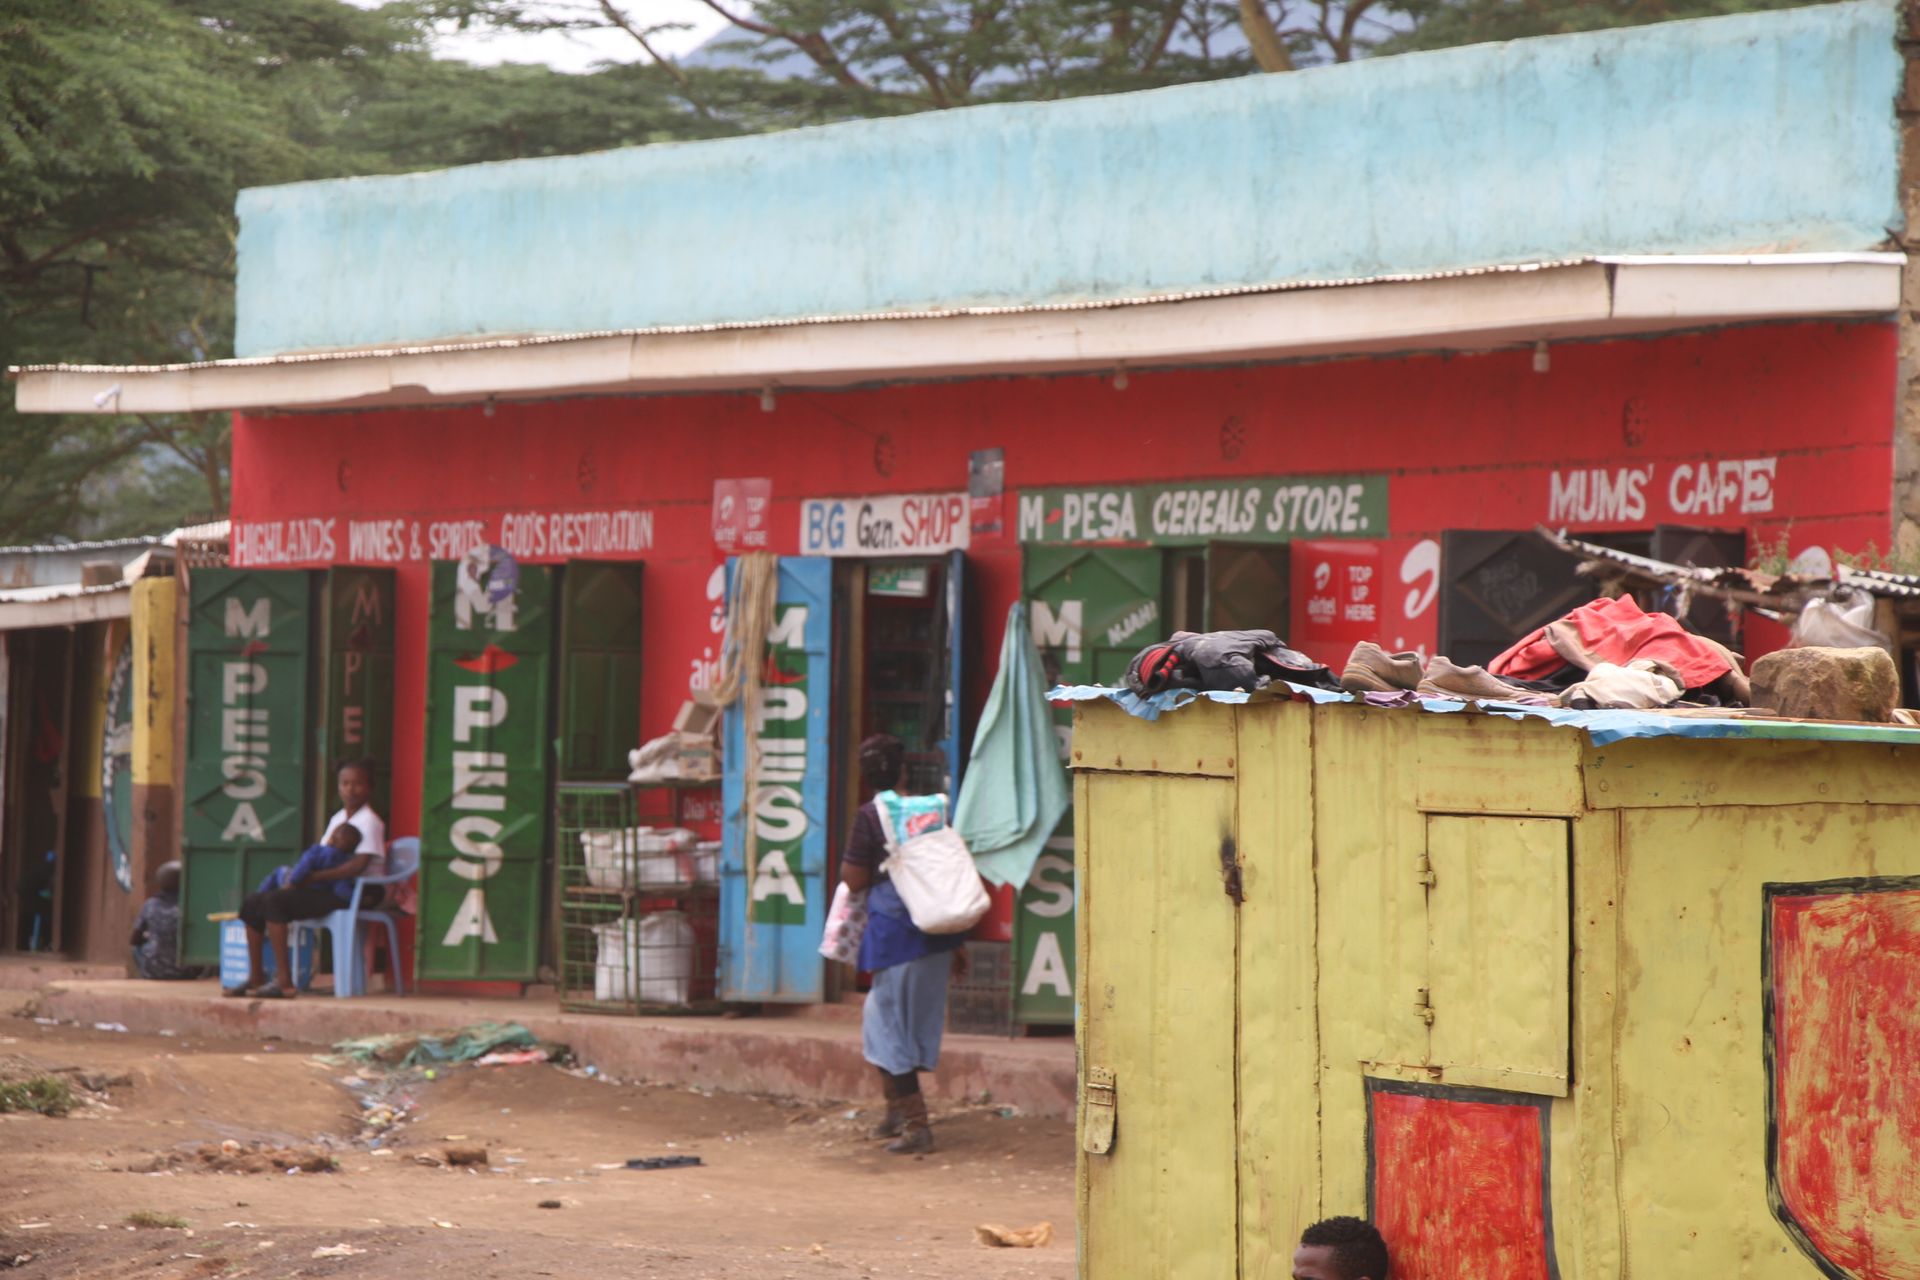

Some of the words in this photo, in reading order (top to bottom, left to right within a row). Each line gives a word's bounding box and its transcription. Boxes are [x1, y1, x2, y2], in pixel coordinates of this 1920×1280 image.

[1152, 487, 1261, 536] CEREALS
[1266, 484, 1369, 533] STORE.
[1549, 463, 1655, 522] MUMS'
[1669, 457, 1777, 515] CAFE
[234, 517, 337, 567] HIGHLANDS
[349, 518, 405, 562] WINES
[409, 521, 422, 561] &
[501, 511, 547, 557] GOD'S
[550, 510, 654, 555] RESTORATION
[808, 502, 846, 549] BG
[857, 502, 899, 548] Gen.
[901, 496, 964, 547] SHOP
[1348, 565, 1373, 583] TOP
[1352, 585, 1369, 602] UP
[1344, 604, 1376, 621] HERE
